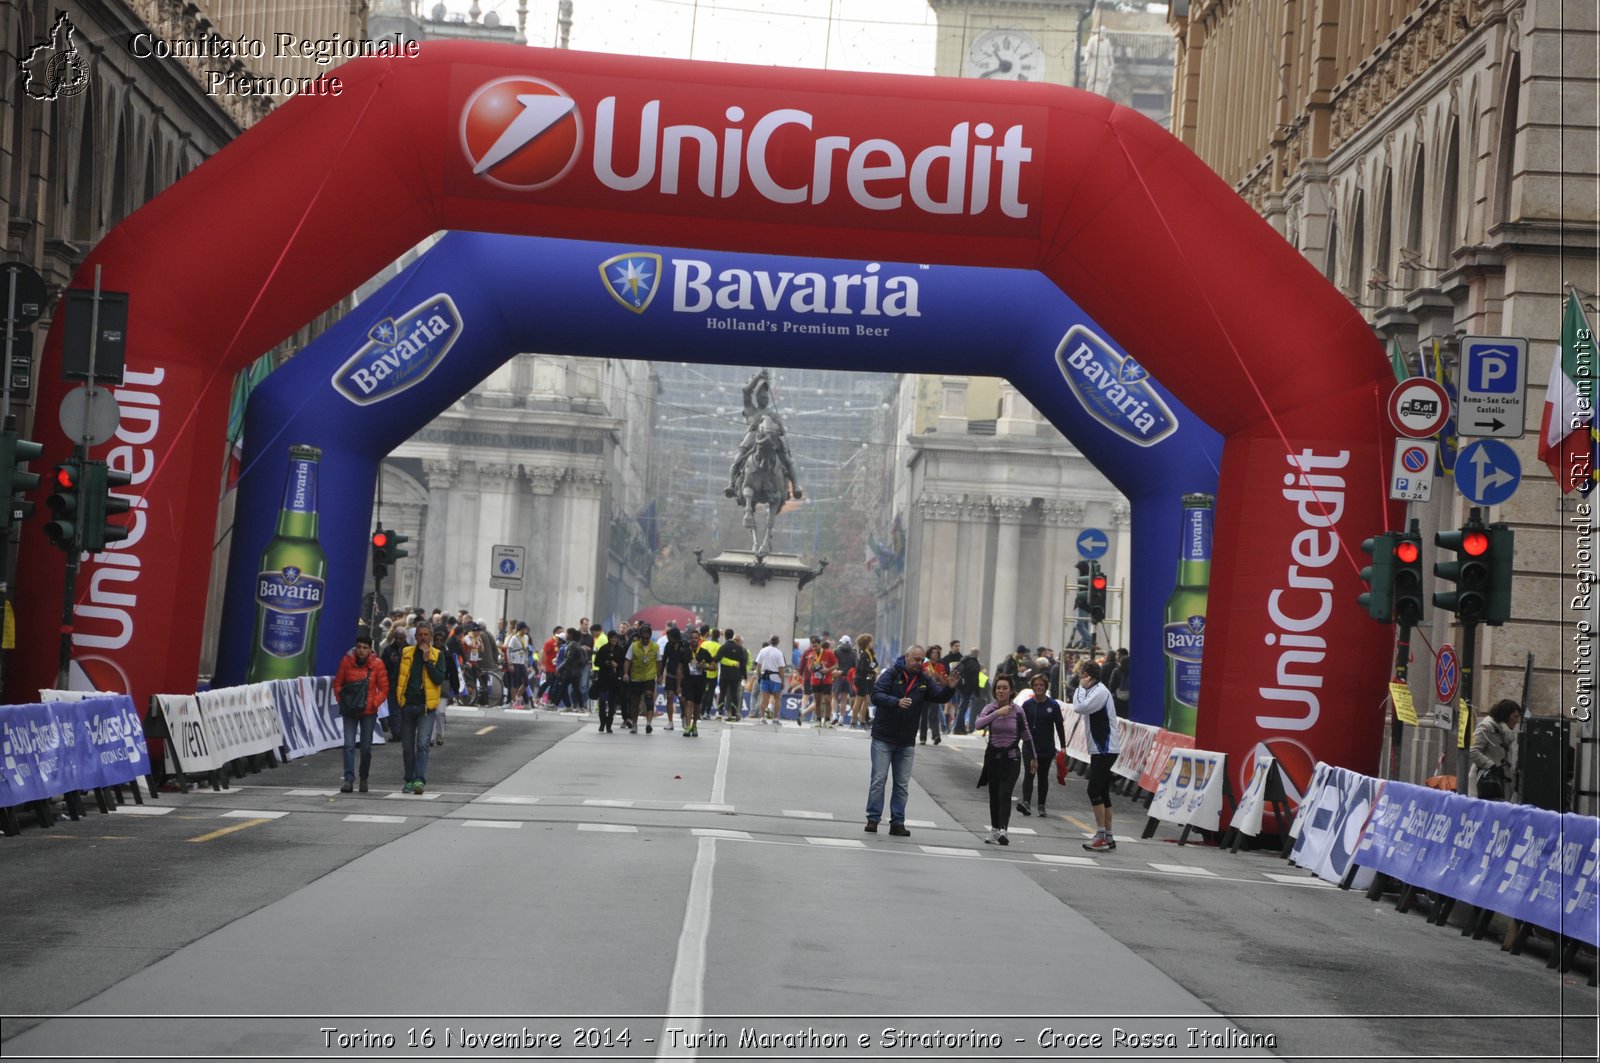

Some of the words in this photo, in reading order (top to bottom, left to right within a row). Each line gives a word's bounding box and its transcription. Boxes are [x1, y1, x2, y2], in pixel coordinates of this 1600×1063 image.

[593, 96, 1032, 218] UniCredit
[672, 258, 921, 317] Bavaria
[706, 317, 778, 332] Holland's
[783, 321, 850, 335] Premium
[856, 324, 890, 337] Beer
[350, 315, 451, 394] Bavaria
[1481, 357, 1507, 389] P
[1067, 342, 1155, 435] Bavaria
[1463, 395, 1482, 403] Roma
[1487, 396, 1500, 404] San
[1501, 397, 1520, 405] Carlo
[1477, 406, 1505, 414] Castello
[293, 462, 308, 509] Bavaria
[1398, 480, 1407, 489] P
[1192, 510, 1203, 556] Bavaria
[260, 580, 320, 601] Bavaria
[1256, 448, 1350, 731] UniCredit
[182, 721, 208, 758] iren
